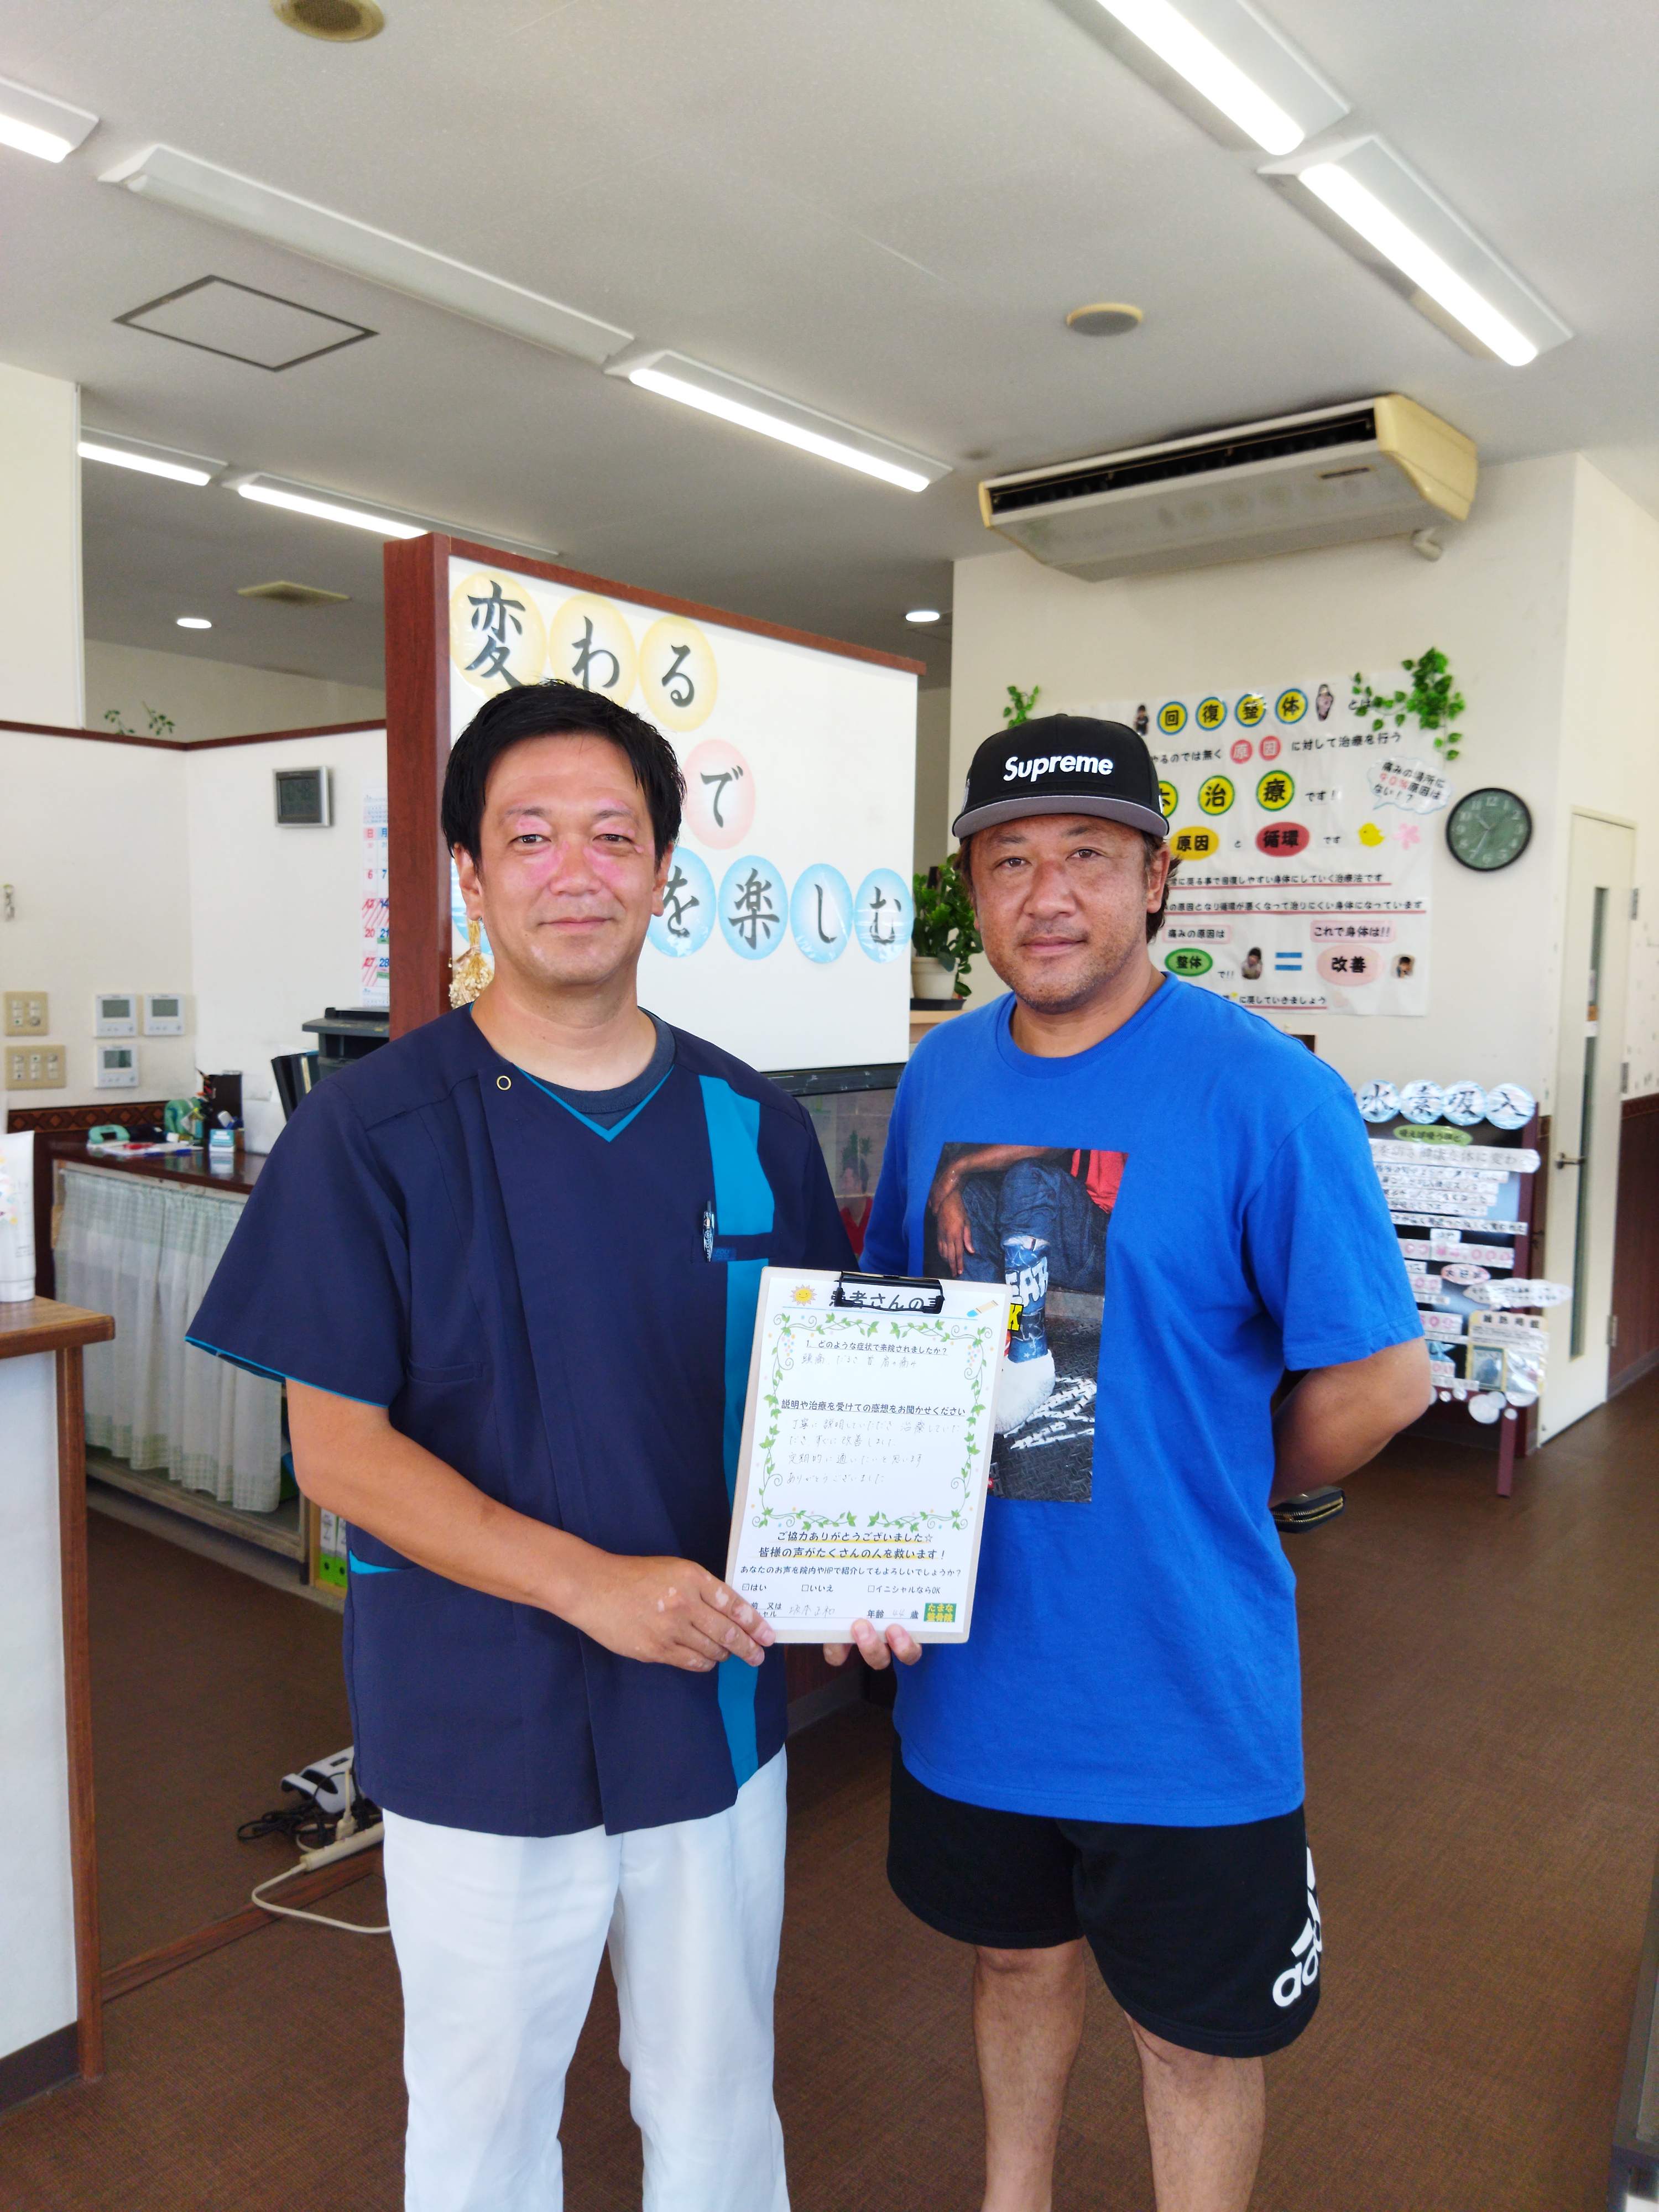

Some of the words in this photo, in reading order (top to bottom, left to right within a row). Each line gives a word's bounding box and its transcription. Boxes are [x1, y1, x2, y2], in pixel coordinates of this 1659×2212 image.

[465, 580, 695, 708] 変わる
[1165, 696, 1299, 727] 回復整体
[1232, 741, 1277, 759] 原因
[1292, 732, 1401, 752] に対して治療を行う
[1002, 755, 1114, 782] Supreme
[367, 829, 373, 838] 日
[1177, 835, 1209, 851] 原因
[1234, 840, 1241, 848] と
[1263, 830, 1298, 848] 循環
[367, 869, 373, 879] 6
[382, 869, 388, 879] 7
[663, 865, 902, 951] を楽しむ
[364, 928, 375, 938] 20
[1167, 929, 1225, 939] 痛みの原因は
[1176, 955, 1202, 969] 整体
[1331, 956, 1367, 974] 改善
[818, 1340, 947, 1355] どのような症状で来院されましたか？
[781, 1399, 966, 1416] 説明や治療を受けての感想をお聞かせください
[759, 1547, 945, 1559] 皆様の声がたくさんの人を救います！
[740, 1566, 961, 1577] あなたのお声を院内やHPで紹介してもよろしいでしょうか？
[810, 1584, 833, 1593] いいえ
[875, 1585, 941, 1594] イニシャルならOK
[867, 1609, 884, 1619] 年齢
[927, 1603, 953, 1613] たまな
